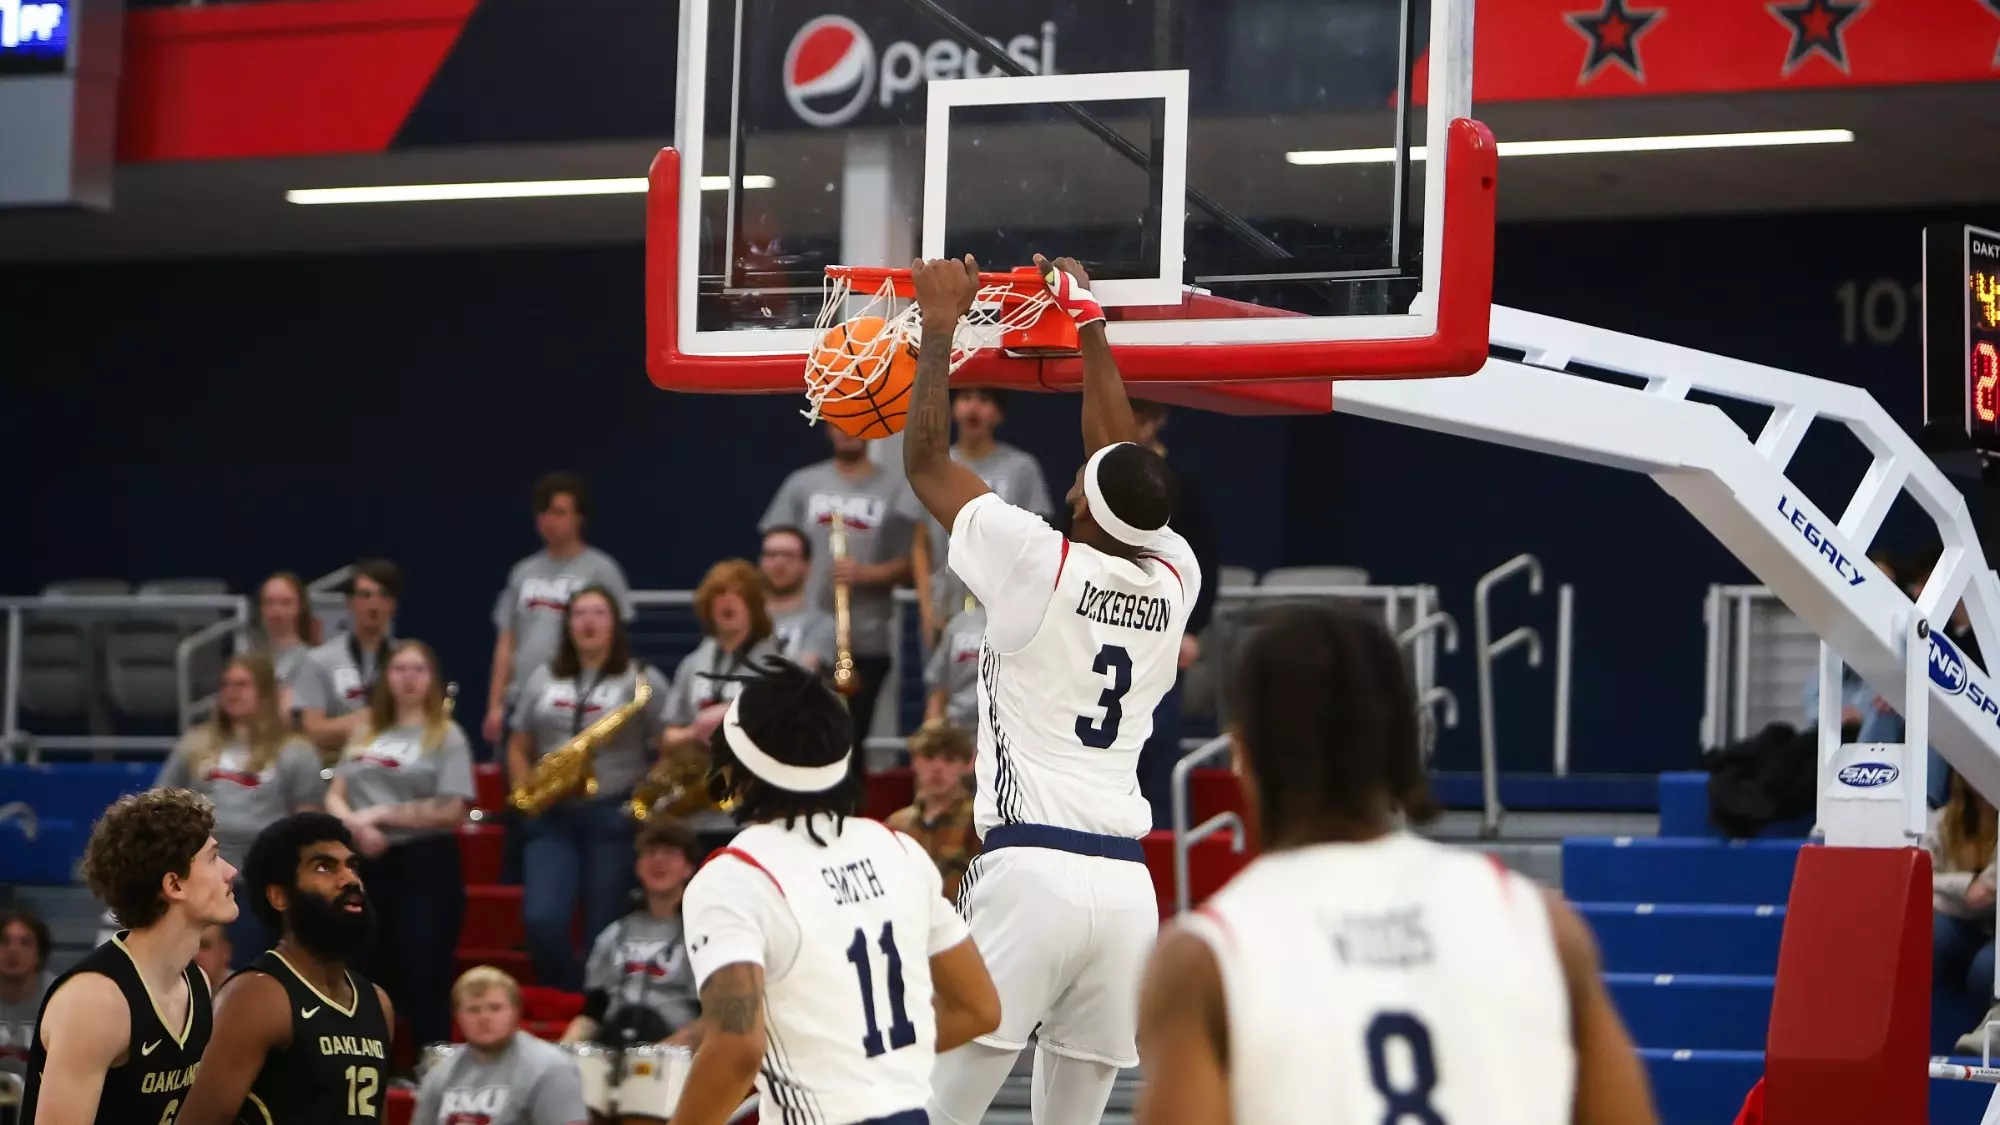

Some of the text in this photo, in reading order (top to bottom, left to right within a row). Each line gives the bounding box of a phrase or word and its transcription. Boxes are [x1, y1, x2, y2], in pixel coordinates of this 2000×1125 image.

[1777, 495, 1866, 586] LEGACY
[1075, 644, 1133, 749] 3
[1929, 637, 2000, 729] NA SP
[1839, 767, 1896, 780] SNA
[846, 920, 917, 1058] 11
[319, 1036, 384, 1059] OAKLAND
[345, 1065, 379, 1117] 12
[1366, 1010, 1447, 1125] 8
